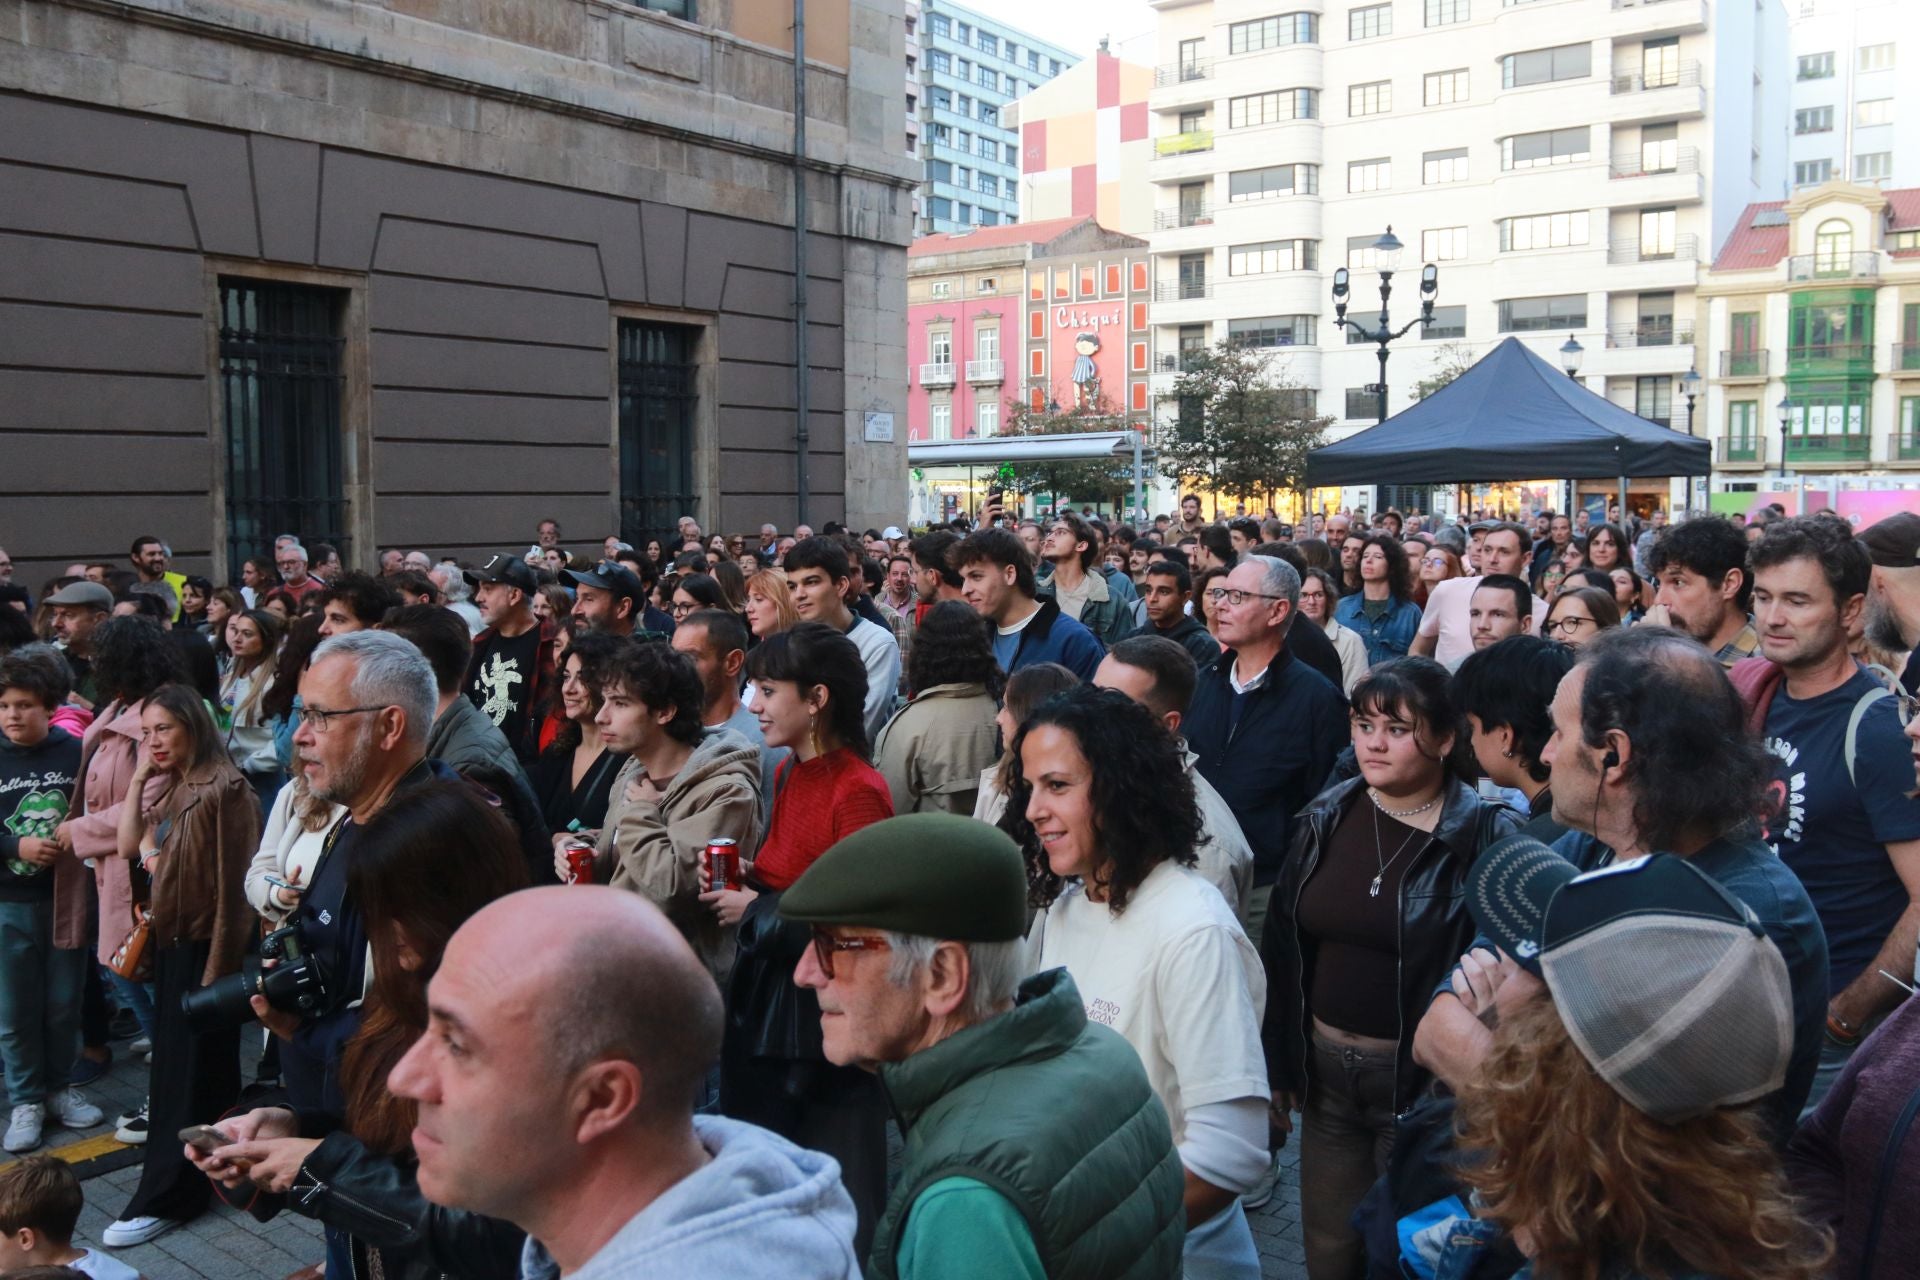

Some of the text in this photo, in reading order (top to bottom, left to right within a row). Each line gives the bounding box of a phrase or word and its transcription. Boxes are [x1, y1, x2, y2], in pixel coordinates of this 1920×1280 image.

[1057, 307, 1120, 332] Chiqui
[1792, 416, 1860, 425] GEOX
[0, 777, 41, 793] olling
